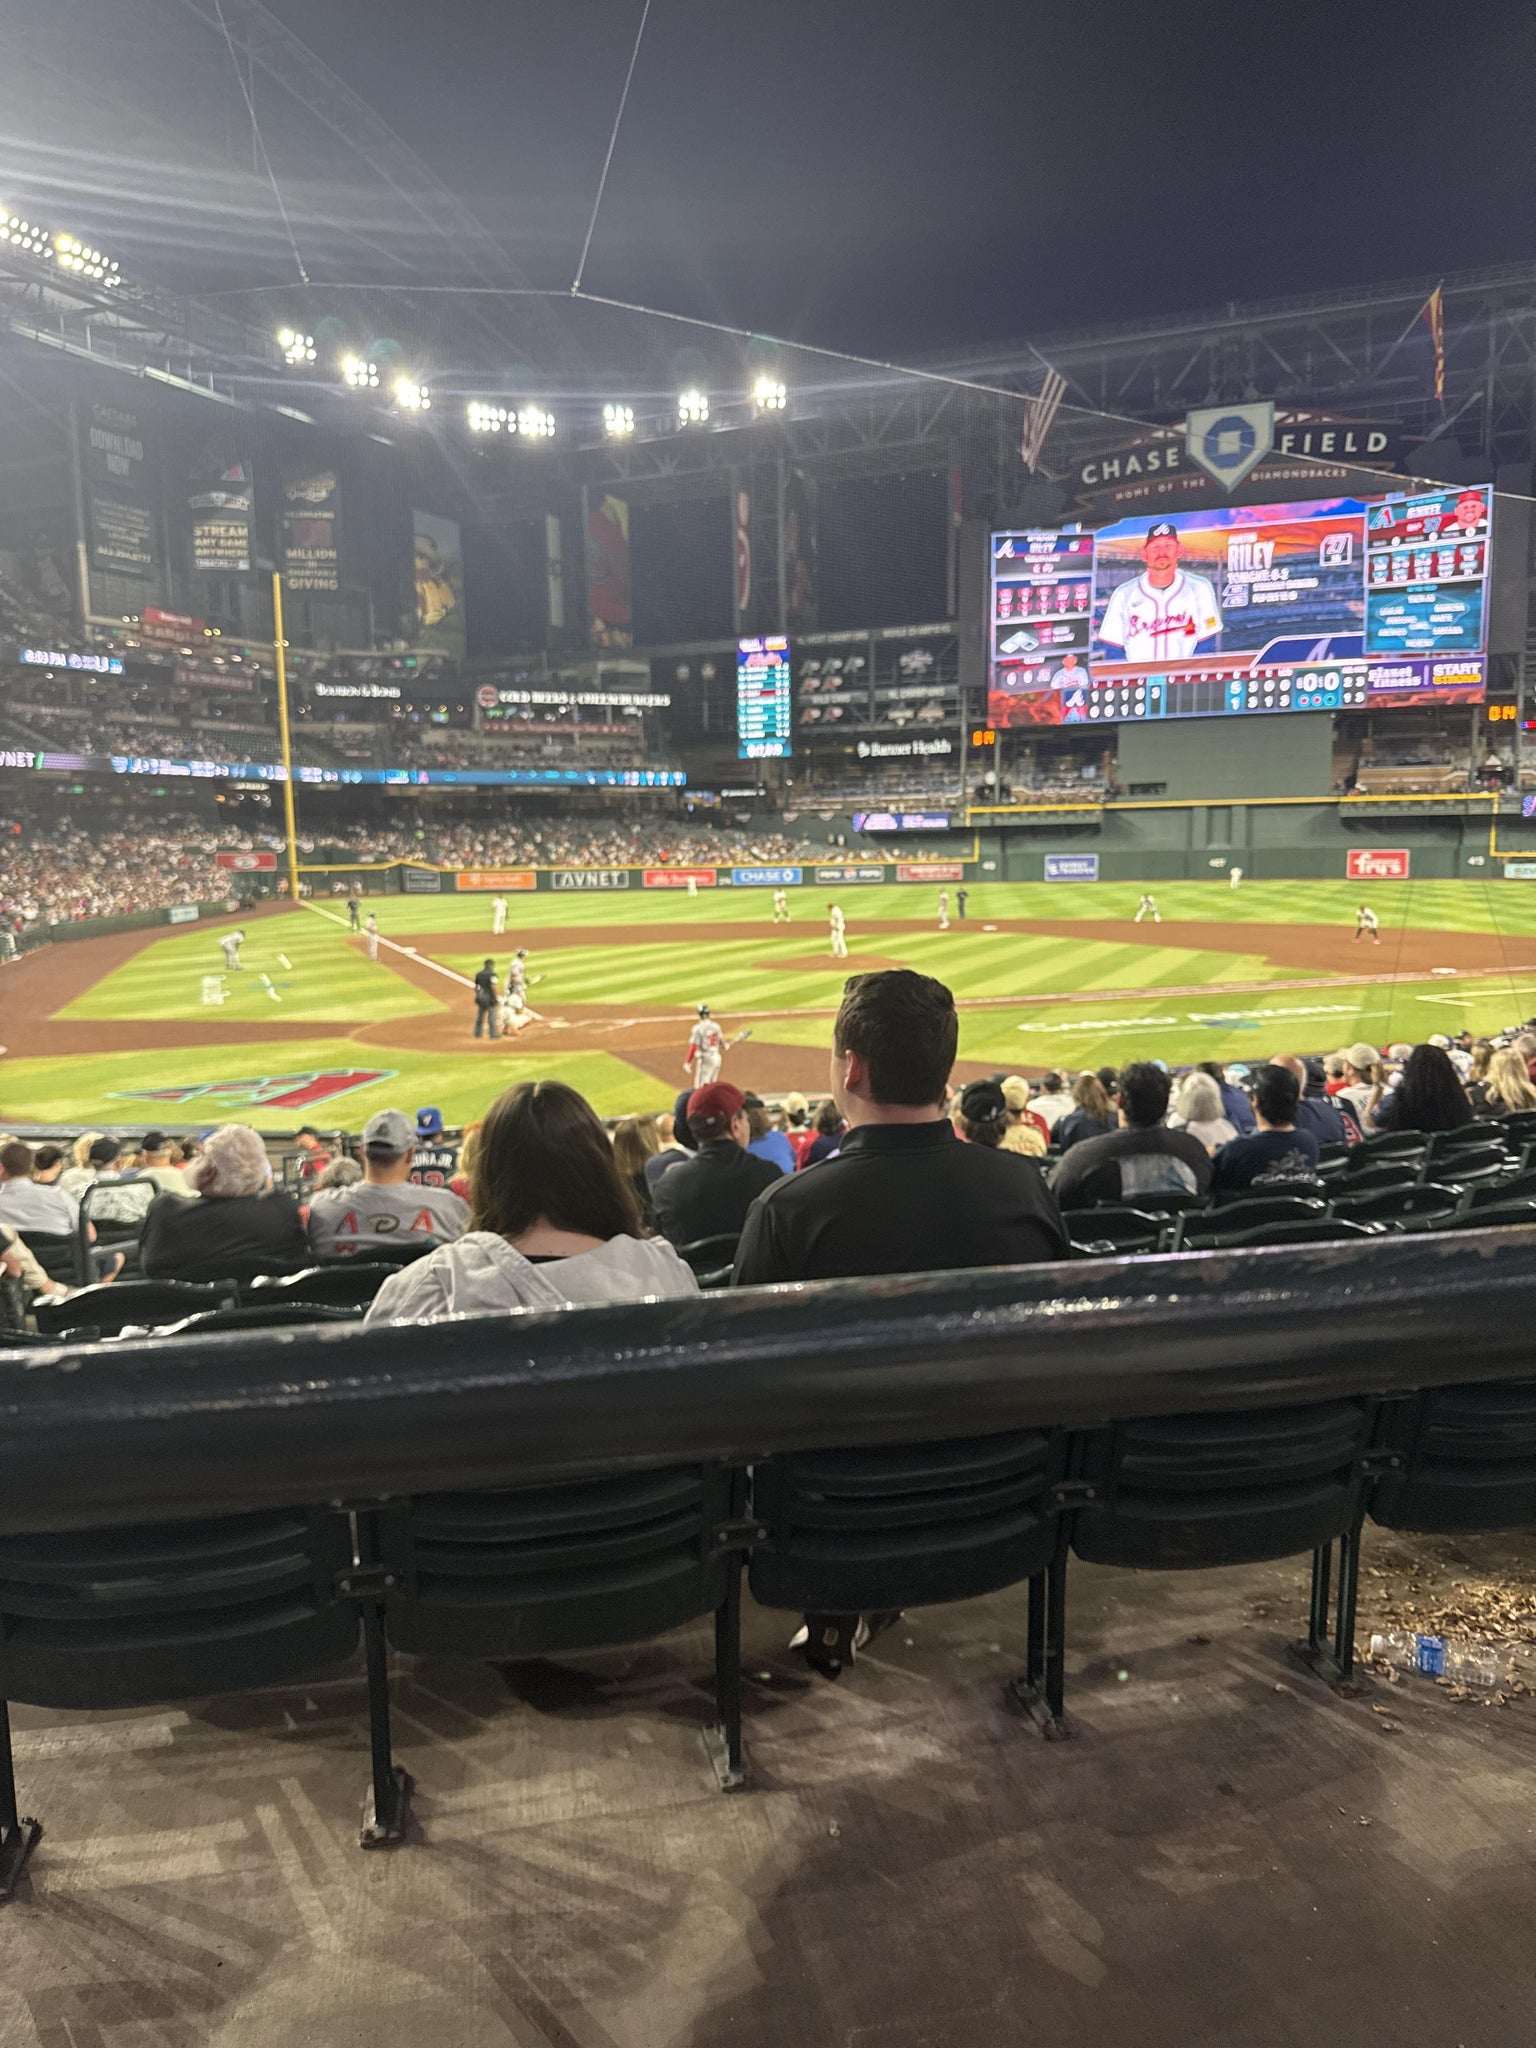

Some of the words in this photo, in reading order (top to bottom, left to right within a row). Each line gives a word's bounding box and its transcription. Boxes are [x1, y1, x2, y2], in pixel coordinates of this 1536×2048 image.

[1081, 448, 1180, 485] CHASE
[1281, 432, 1388, 454] FIELD
[1251, 469, 1348, 481] DIAMONDBACKS
[1115, 486, 1150, 500] HOME
[1158, 482, 1174, 494] OF
[1183, 479, 1206, 490] THE
[193, 525, 248, 537] STREAM
[1423, 517, 1442, 533] 37
[194, 538, 216, 547] ANY
[220, 539, 248, 547] GAME
[1326, 537, 1346, 554] 27
[195, 548, 248, 557] ANYWHERE
[287, 549, 337, 560] MILLION
[1228, 541, 1275, 571] RILEY
[287, 579, 338, 590] GIVING
[1227, 570, 1271, 584] TONIGHT:
[1433, 662, 1482, 677] START
[1304, 673, 1318, 692] 0
[1324, 672, 1339, 691] 0
[1343, 677, 1353, 688] 2
[1104, 689, 1115, 702] 0
[1230, 681, 1242, 694] 5
[1104, 704, 1115, 717] 0
[1231, 697, 1240, 710] 1
[1264, 695, 1273, 707] 1
[871, 741, 911, 757] Banner
[913, 738, 952, 755] Health
[561, 871, 621, 887] AVNET
[740, 870, 781, 882] CHASE
